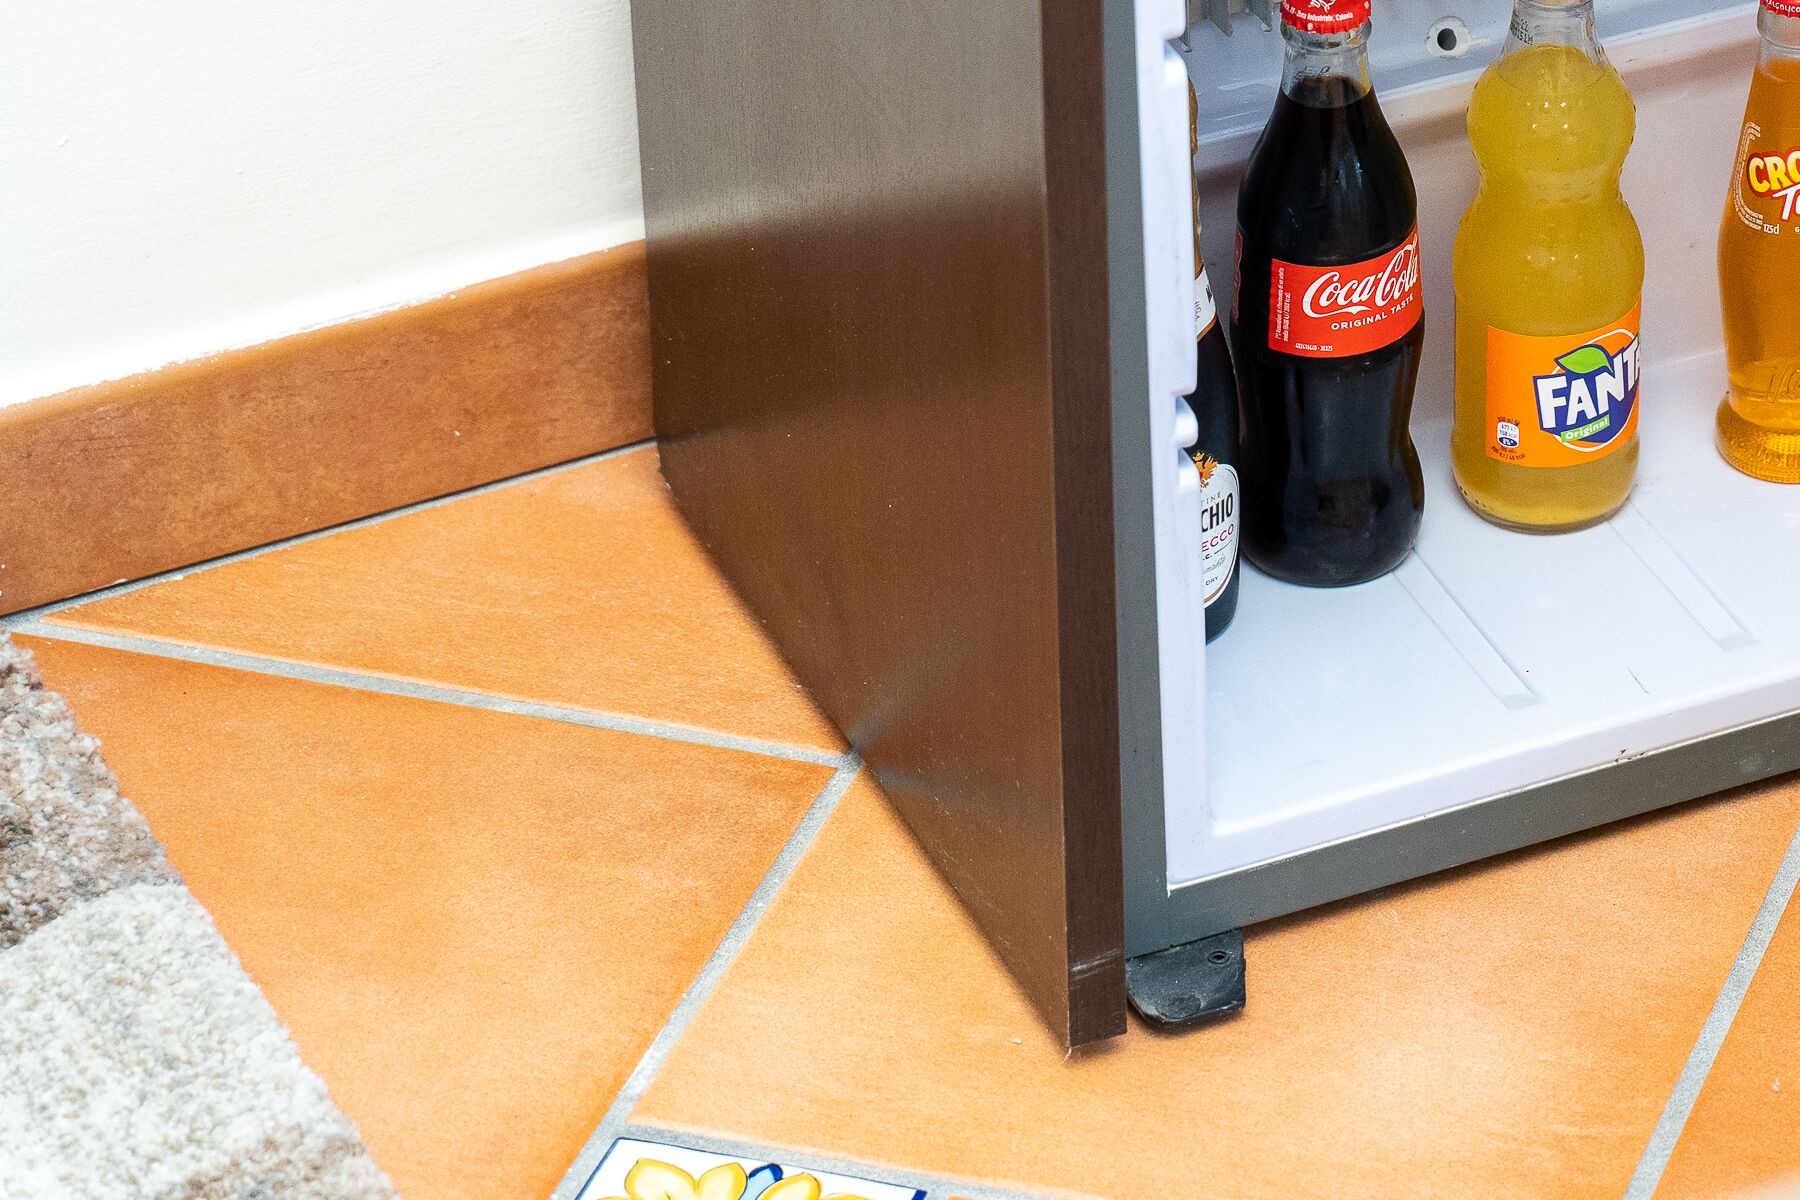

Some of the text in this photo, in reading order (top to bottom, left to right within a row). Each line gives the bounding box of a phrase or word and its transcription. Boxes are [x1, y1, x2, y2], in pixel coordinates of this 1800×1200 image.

[1302, 233, 1418, 318] Coca-Cola
[1331, 293, 1414, 331] ORIGINAL TASTE
[1565, 417, 1609, 439] Original
[1206, 575, 1219, 586] DRY
